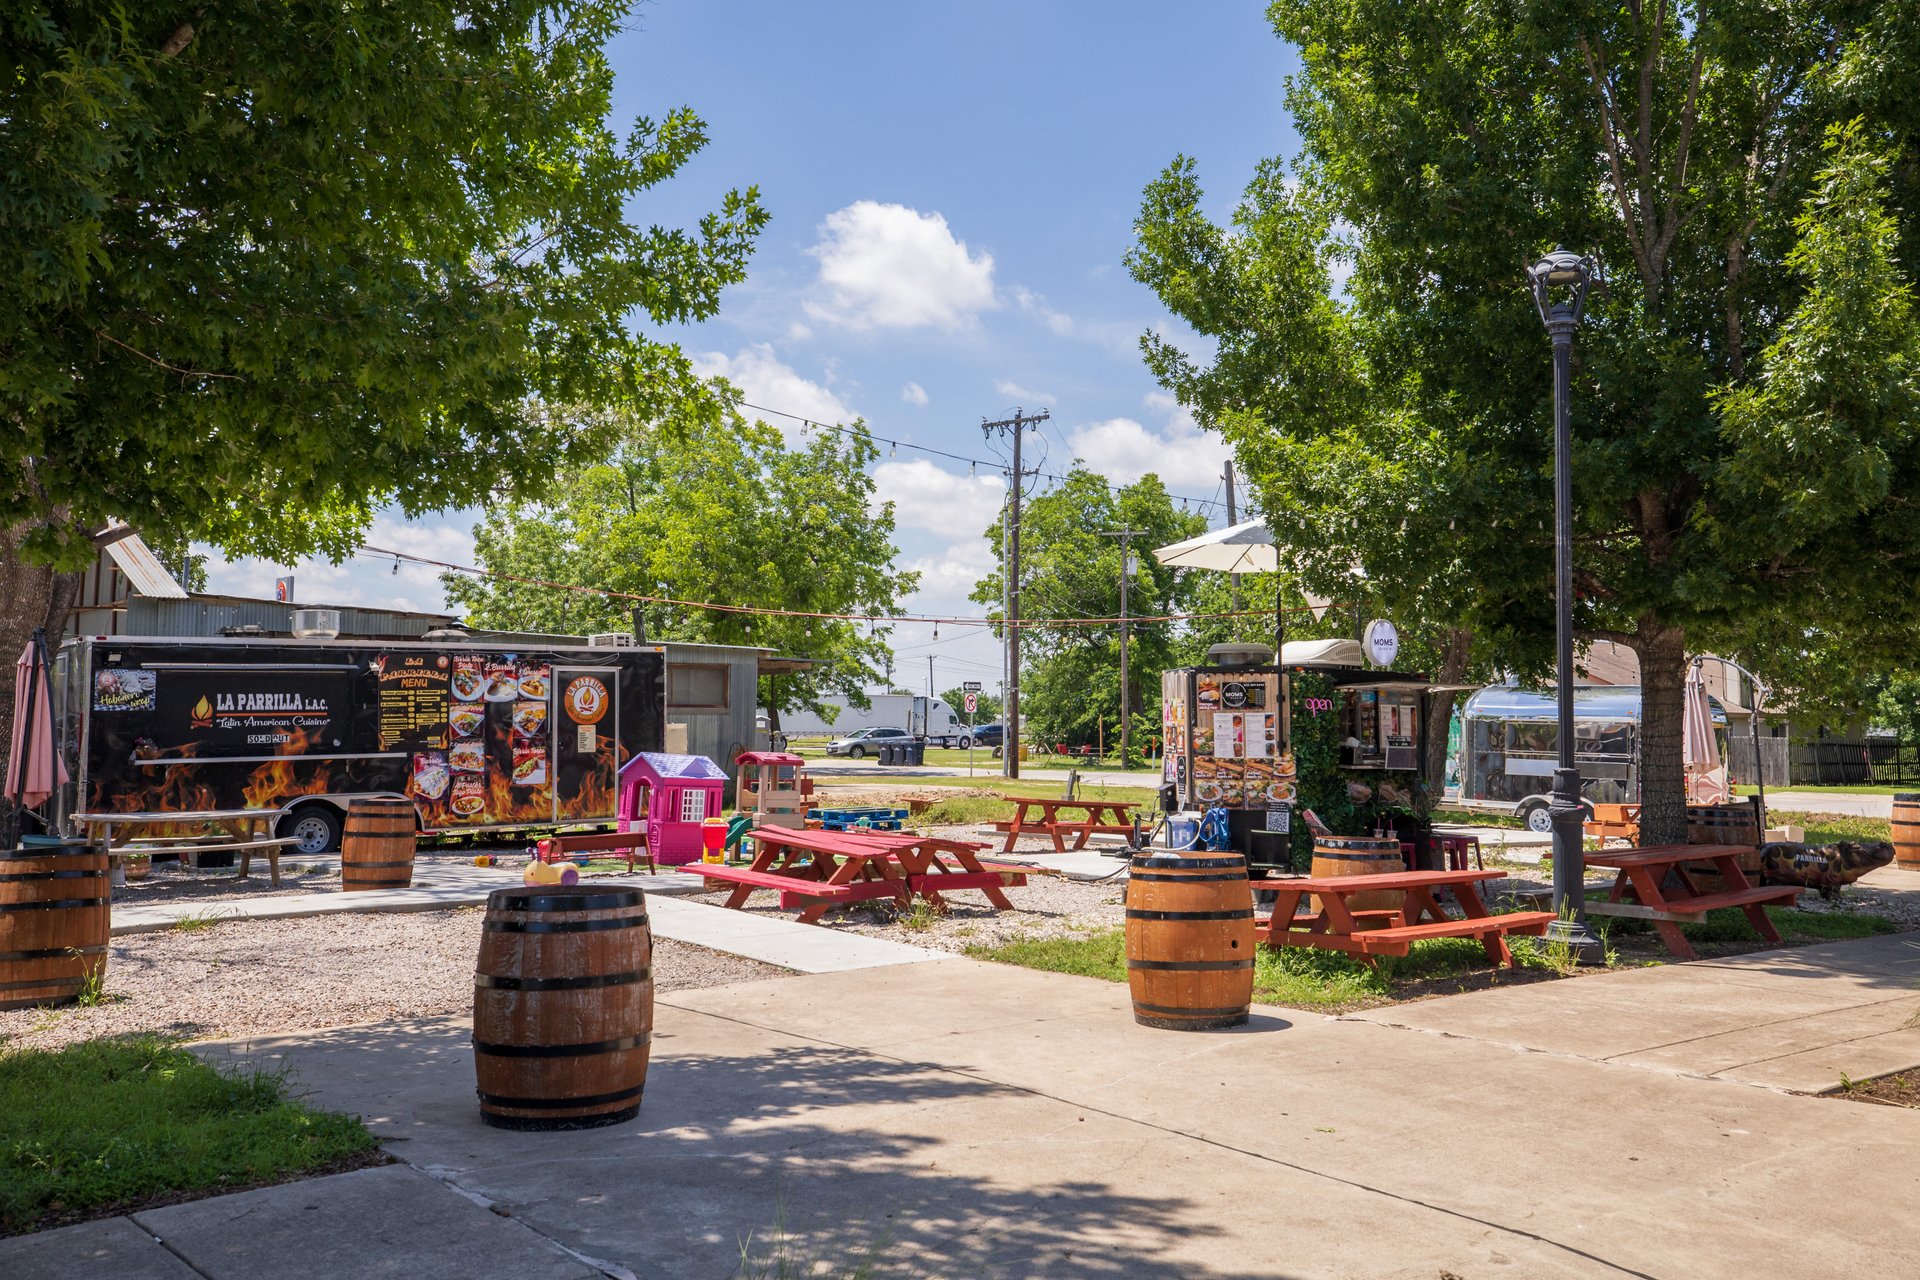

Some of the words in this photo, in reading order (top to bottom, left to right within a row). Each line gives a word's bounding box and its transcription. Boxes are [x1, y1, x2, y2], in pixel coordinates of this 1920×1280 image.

[380, 669, 448, 682] PARRILLA
[401, 678, 428, 688] MENU
[567, 686, 577, 696] LA
[575, 678, 606, 698] PARRILLA
[100, 692, 140, 706] Habanero
[131, 698, 150, 708] wrap
[216, 694, 234, 710] LA
[238, 694, 302, 710] PARRILLA
[1305, 698, 1332, 718] open
[244, 716, 291, 727] American
[248, 735, 271, 743] SOLD
